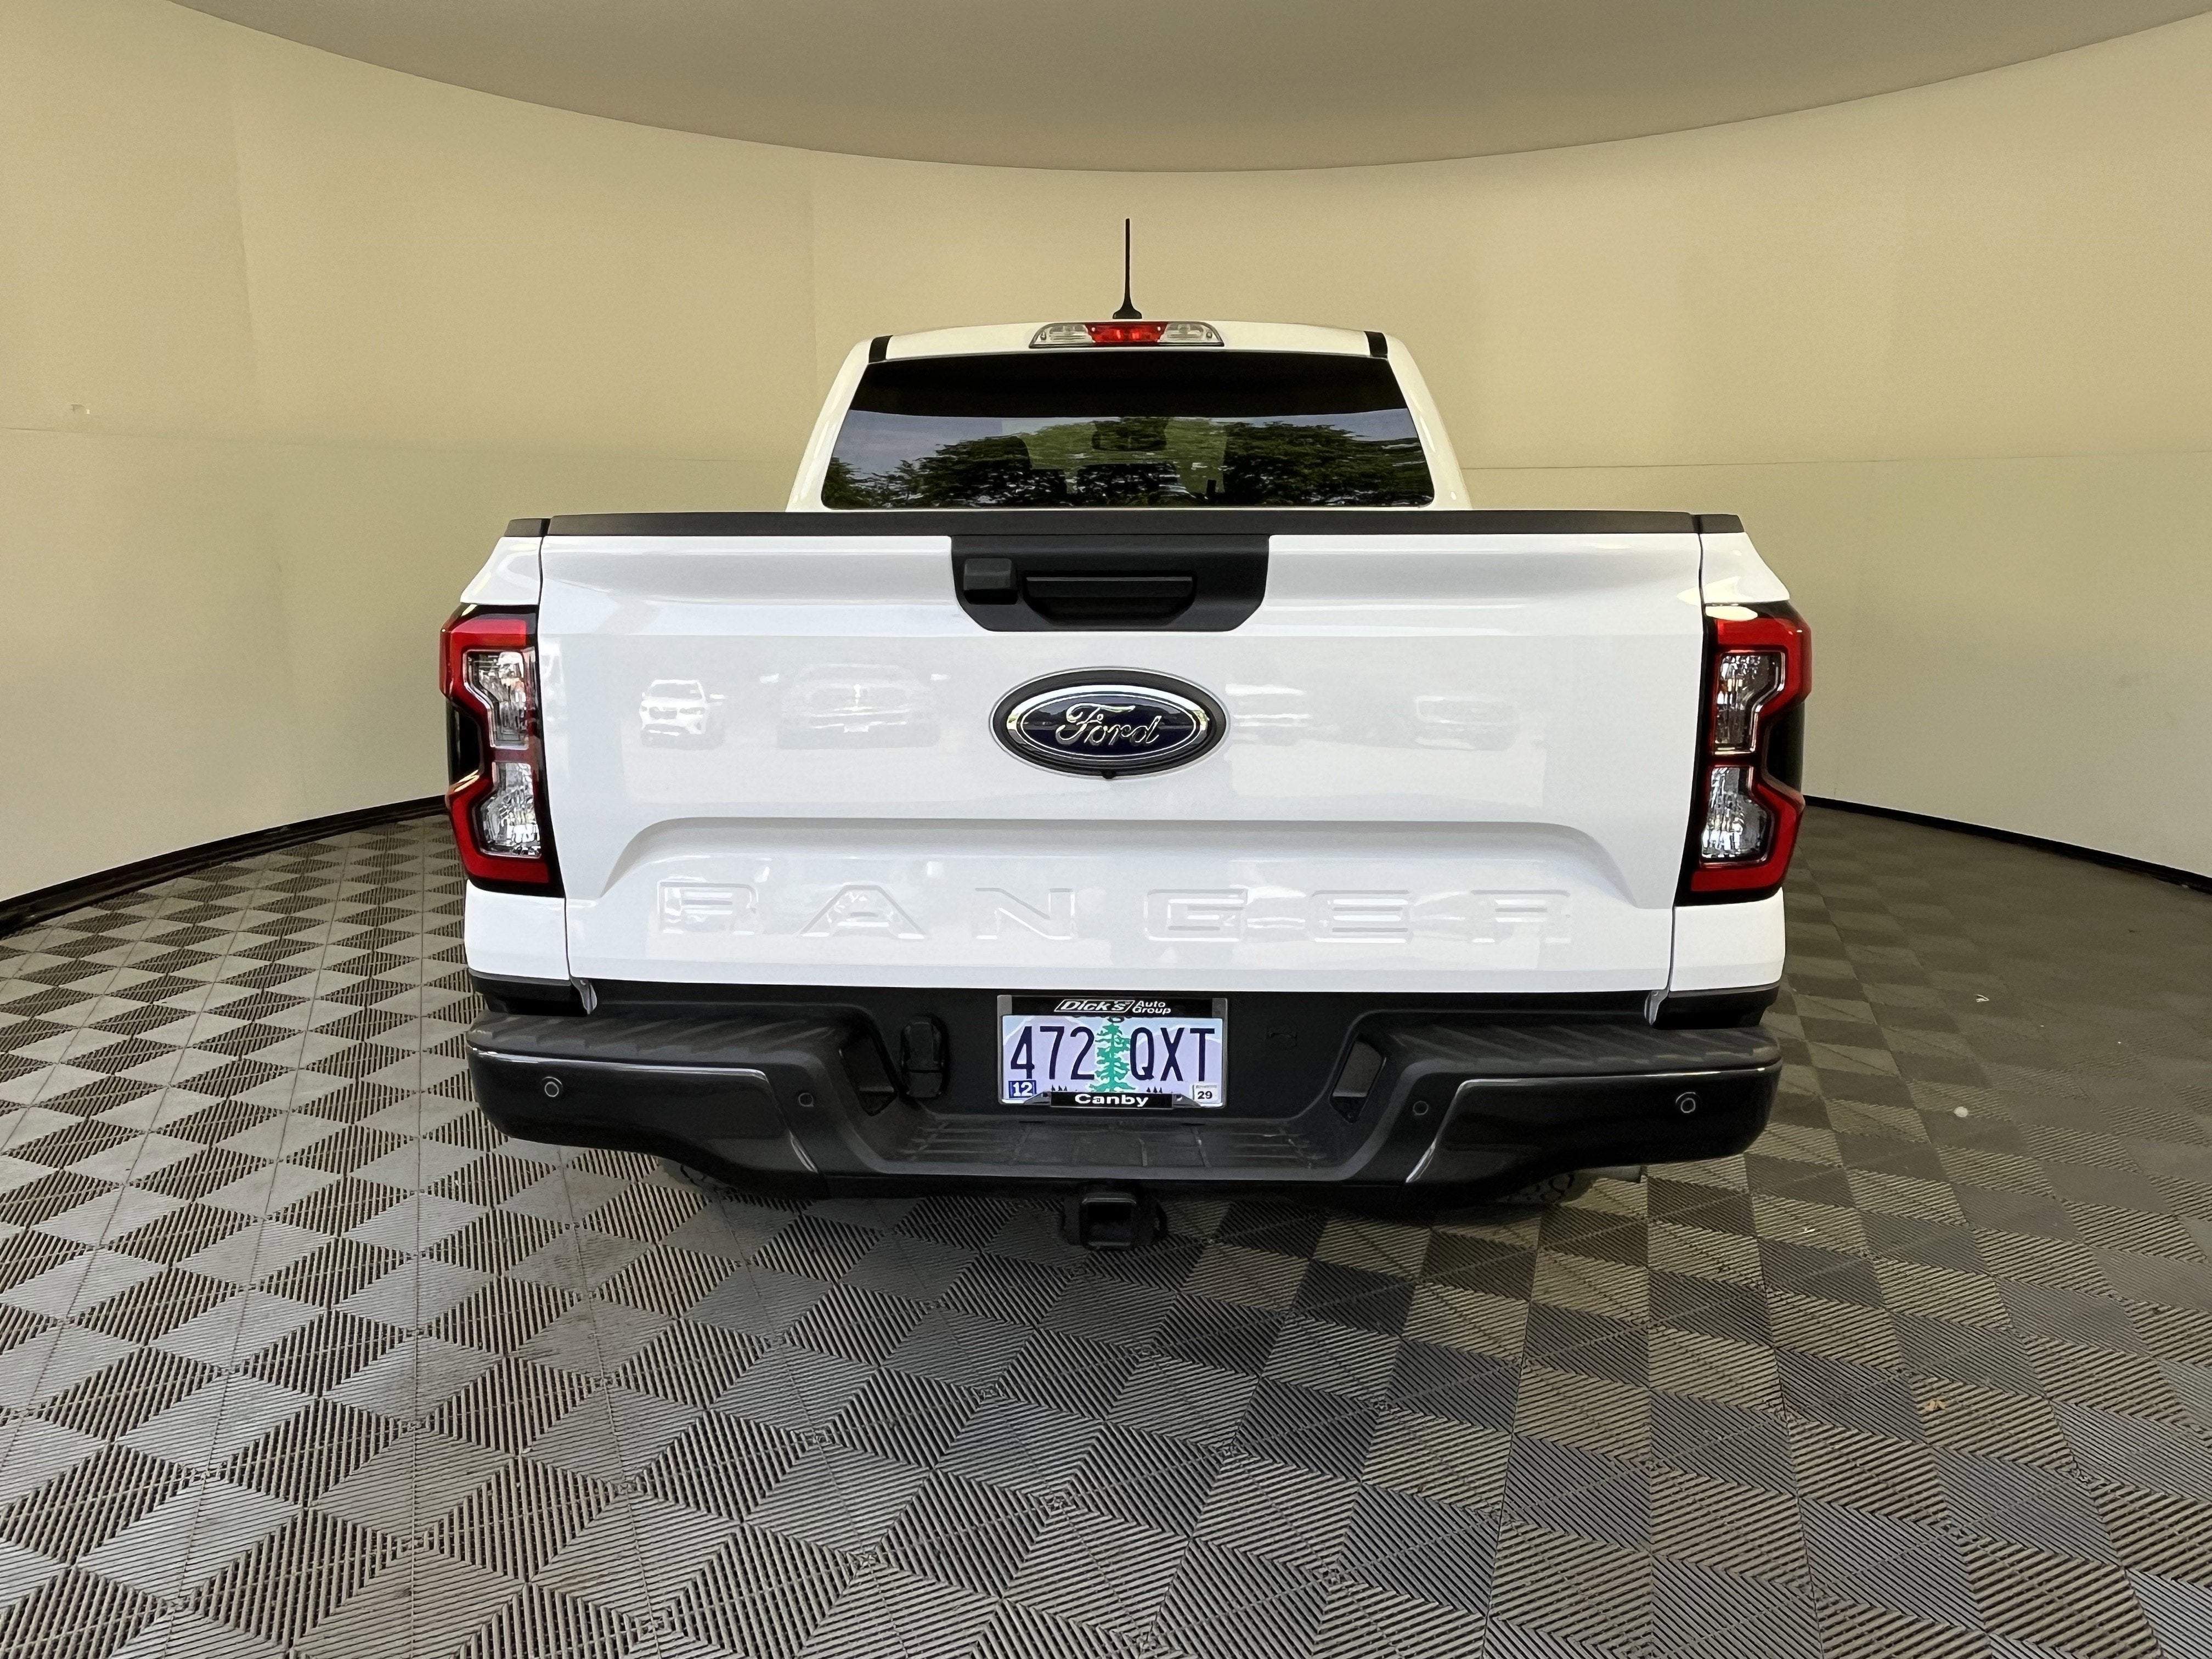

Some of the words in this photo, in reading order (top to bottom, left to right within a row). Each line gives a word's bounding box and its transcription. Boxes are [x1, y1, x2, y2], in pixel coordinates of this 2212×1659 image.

[1055, 703, 1162, 746] Ford
[658, 881, 1572, 944] RANGER
[1060, 1000, 1126, 1011] Dick's
[1132, 1006, 1172, 1015] Group
[1010, 1025, 1096, 1080] 472
[1129, 1026, 1216, 1082] QXT
[1013, 1081, 1033, 1097] 12
[1197, 1091, 1213, 1099] 29
[1074, 1093, 1149, 1108] Canby
